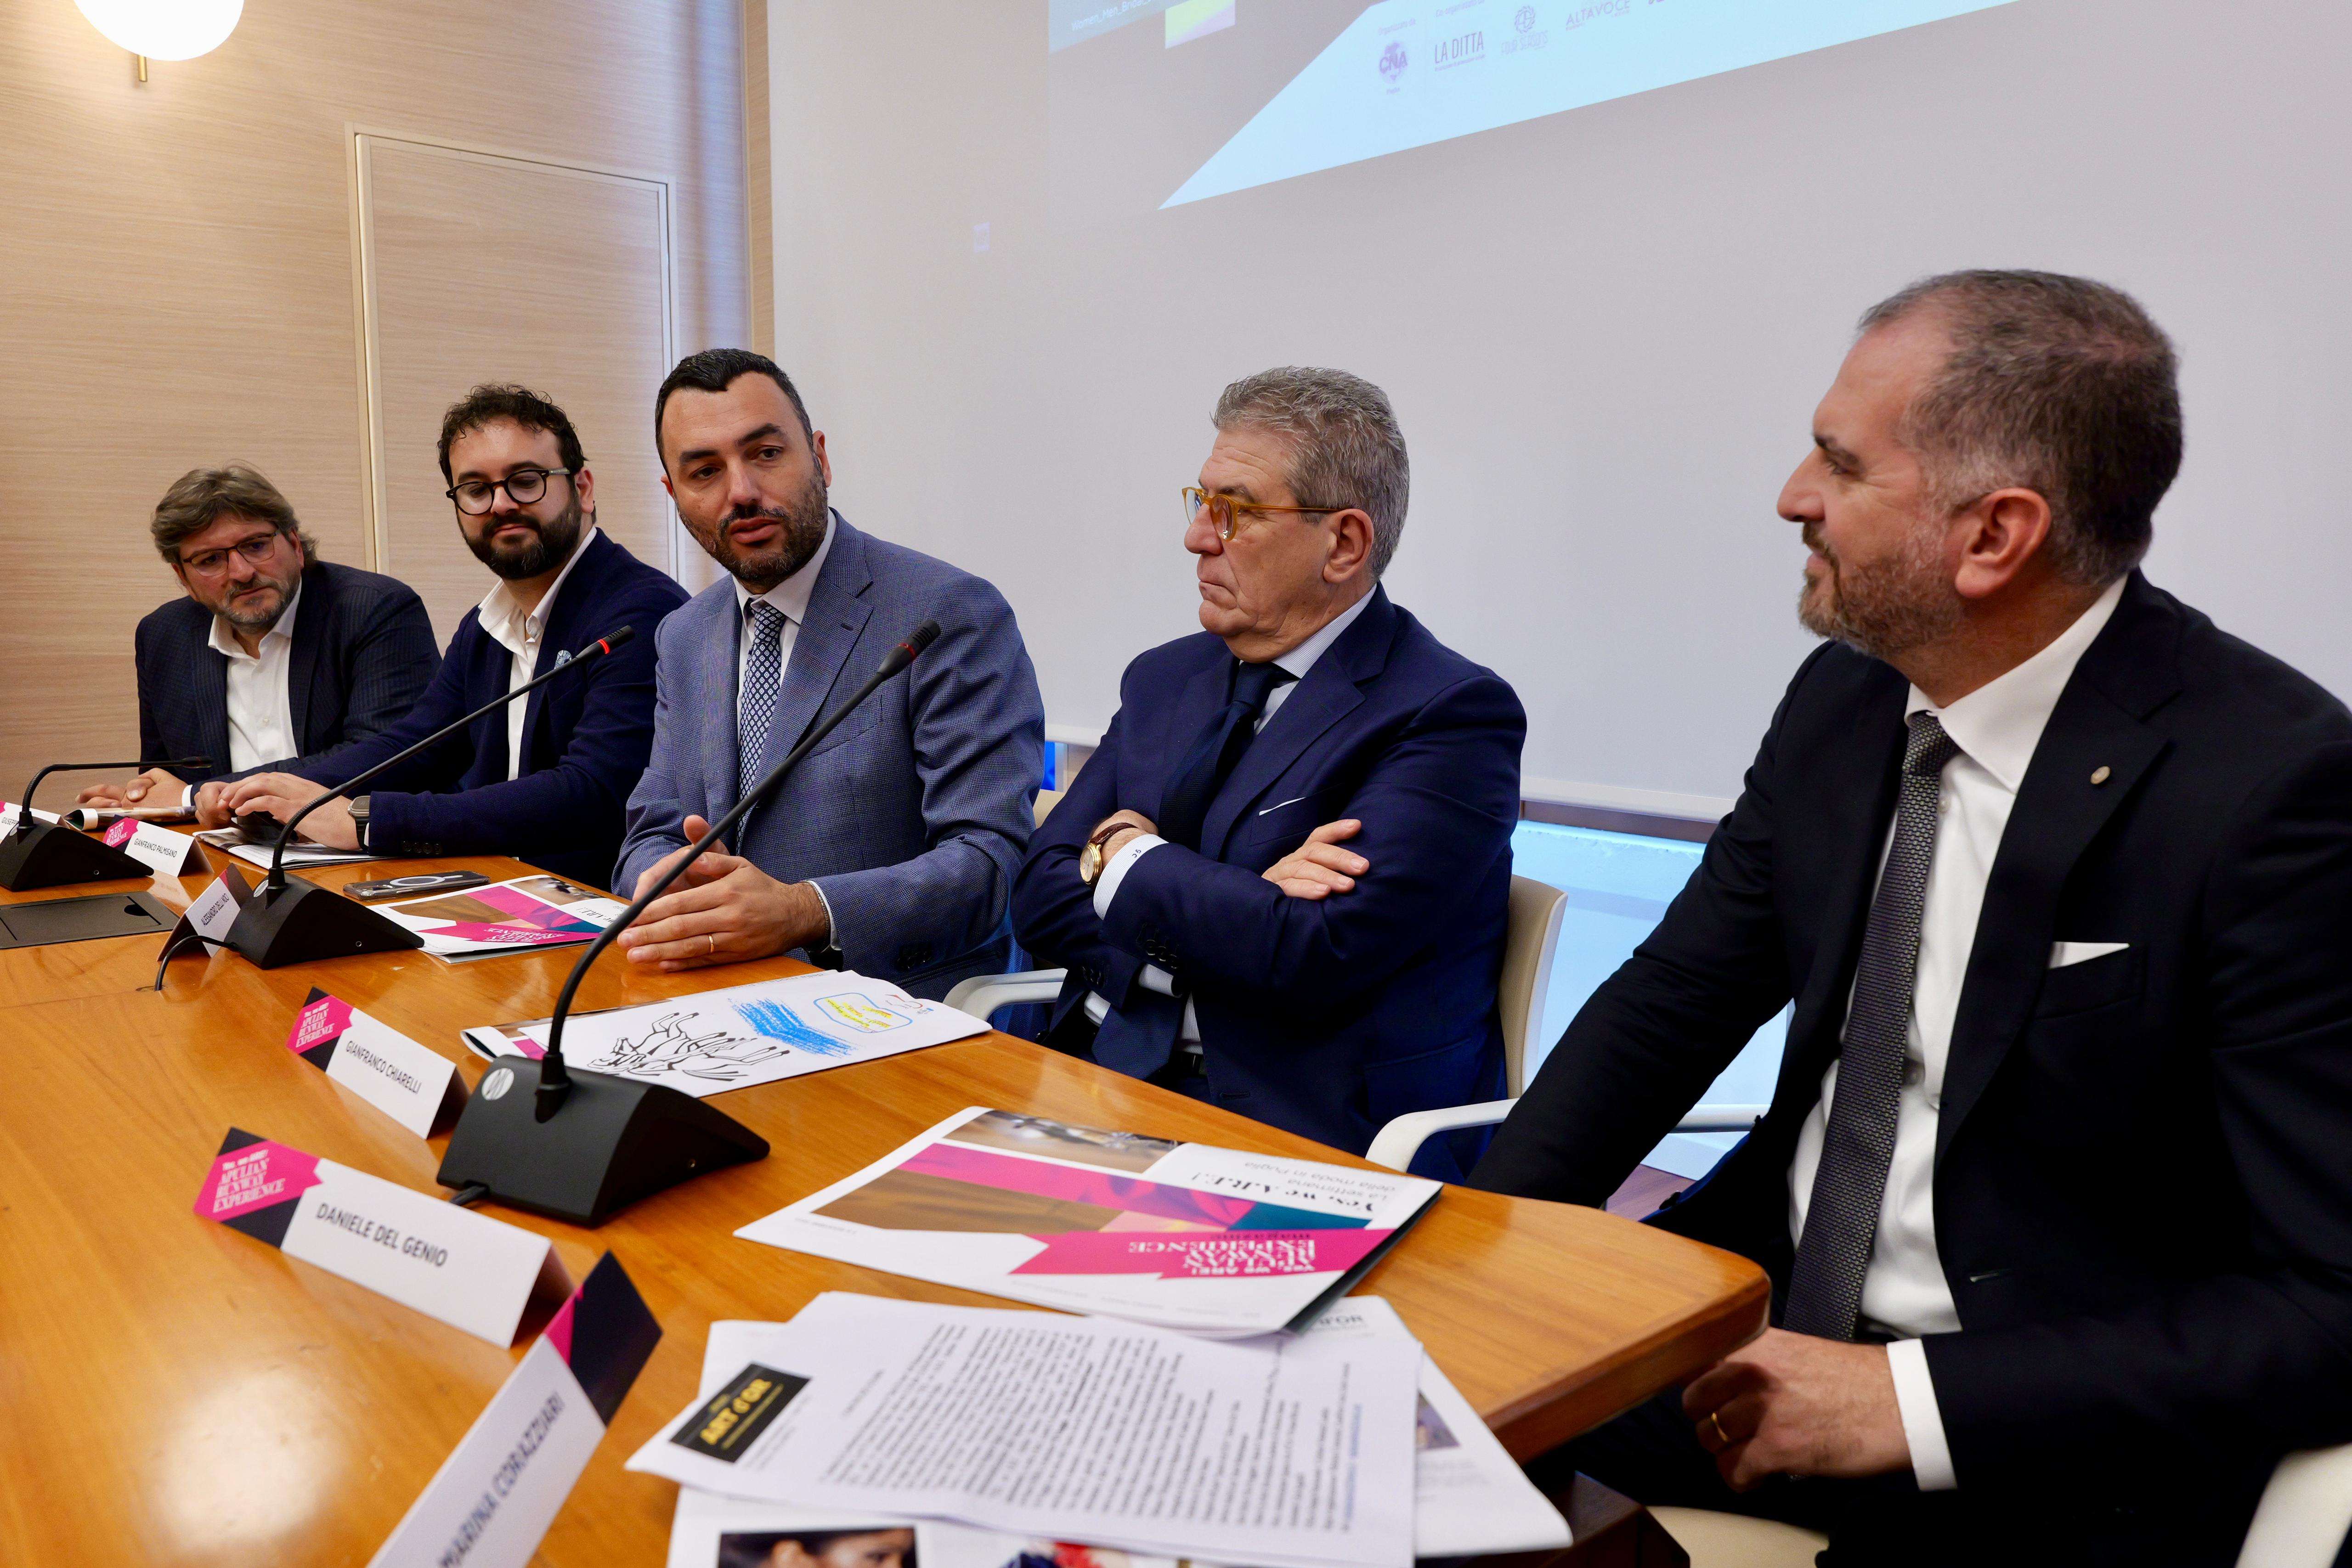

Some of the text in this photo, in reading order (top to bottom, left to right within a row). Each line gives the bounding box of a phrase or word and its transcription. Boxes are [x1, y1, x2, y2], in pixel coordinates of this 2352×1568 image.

[1566, 0, 1630, 26] ALTAVOCE
[1435, 41, 1448, 64] LA
[1452, 31, 1484, 59] DITTA
[1380, 51, 1408, 74] CNA
[2, 817, 19, 826] GIUSEPP
[134, 838, 177, 858] GIANFRANCO PALMISANO
[346, 1040, 422, 1094] GIANFRANCO CHIARELLI
[219, 1158, 269, 1184] APULIAN
[1245, 1161, 1289, 1174] Puglia
[1288, 1179, 1363, 1197] settimana
[1312, 1174, 1356, 1185] moda
[1360, 1183, 1396, 1193] della
[213, 1178, 286, 1213] EXPERIENCE
[317, 1202, 448, 1267] DANIELE DEL GENIO
[1128, 1240, 1315, 1253] EXPERIENCE
